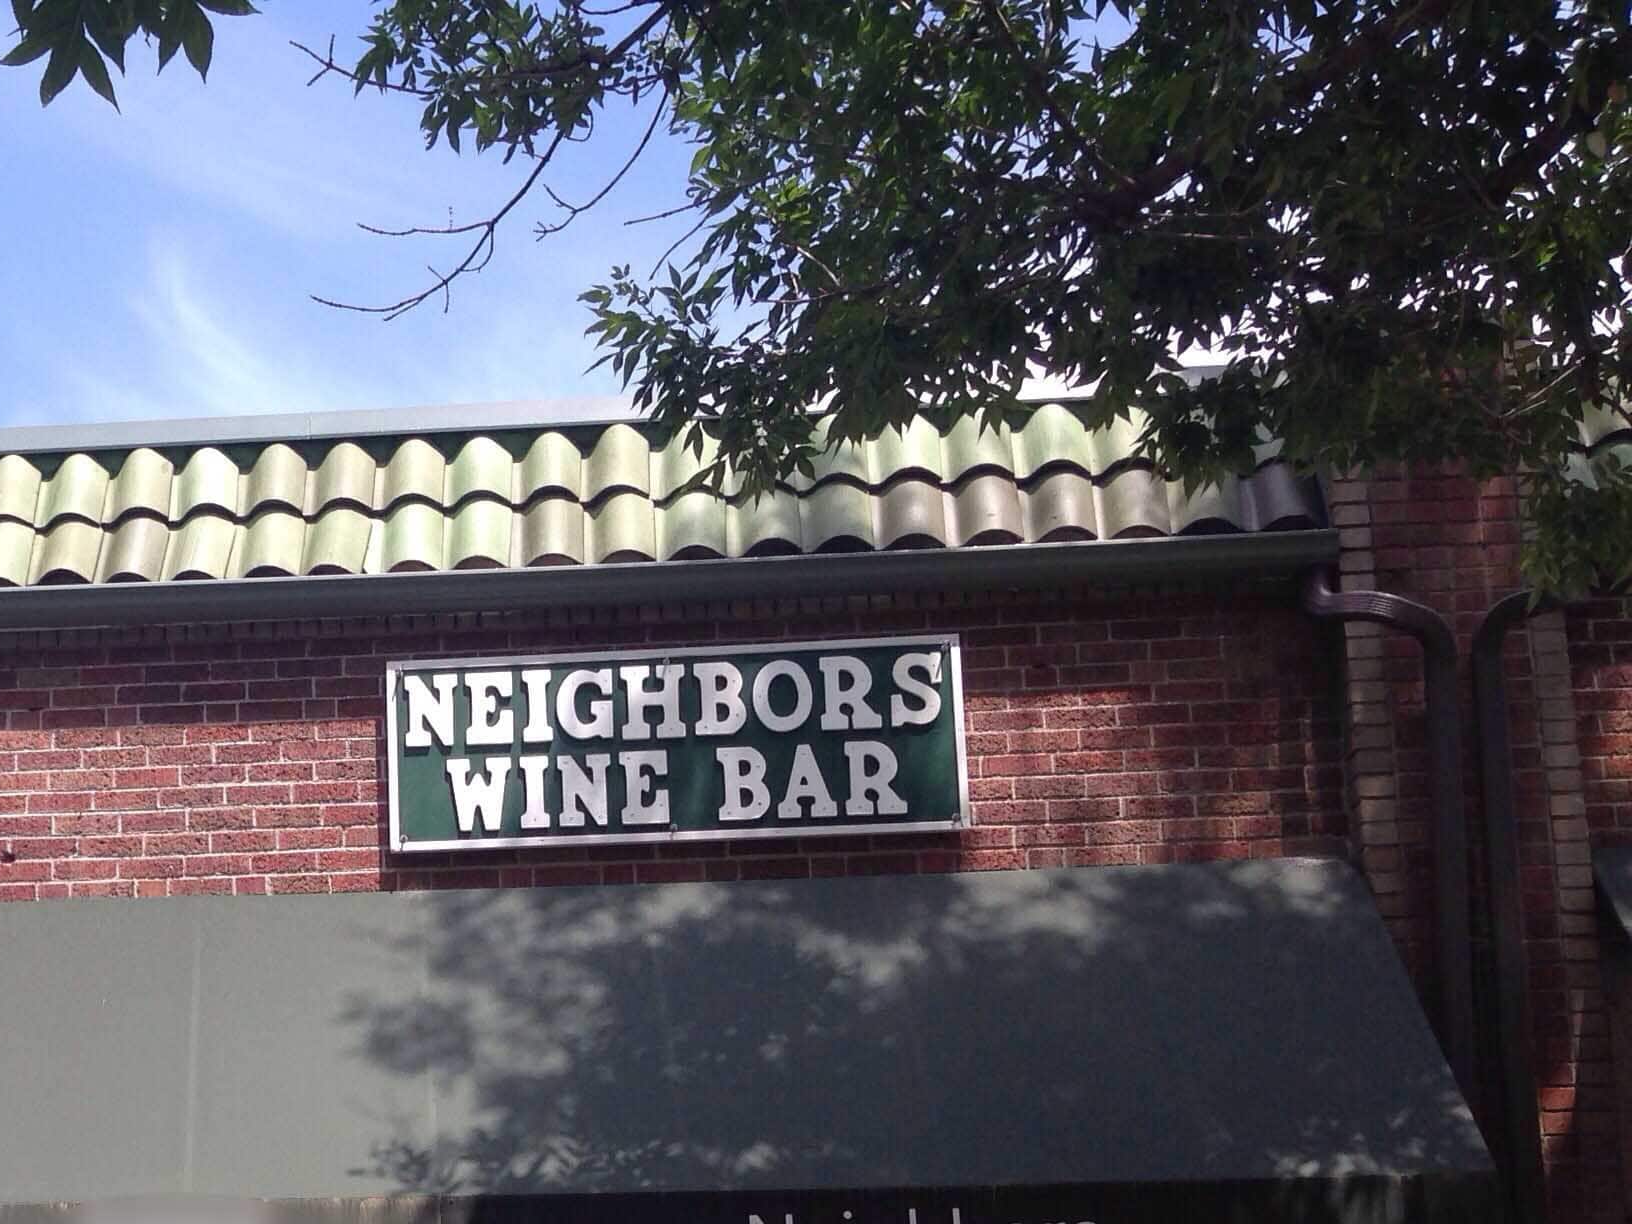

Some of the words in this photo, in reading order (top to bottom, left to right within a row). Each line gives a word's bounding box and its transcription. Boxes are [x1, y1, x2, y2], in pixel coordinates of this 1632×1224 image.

[404, 652, 943, 748] NEIGHBORS
[445, 750, 669, 832] WINE
[716, 740, 908, 821] BAR
